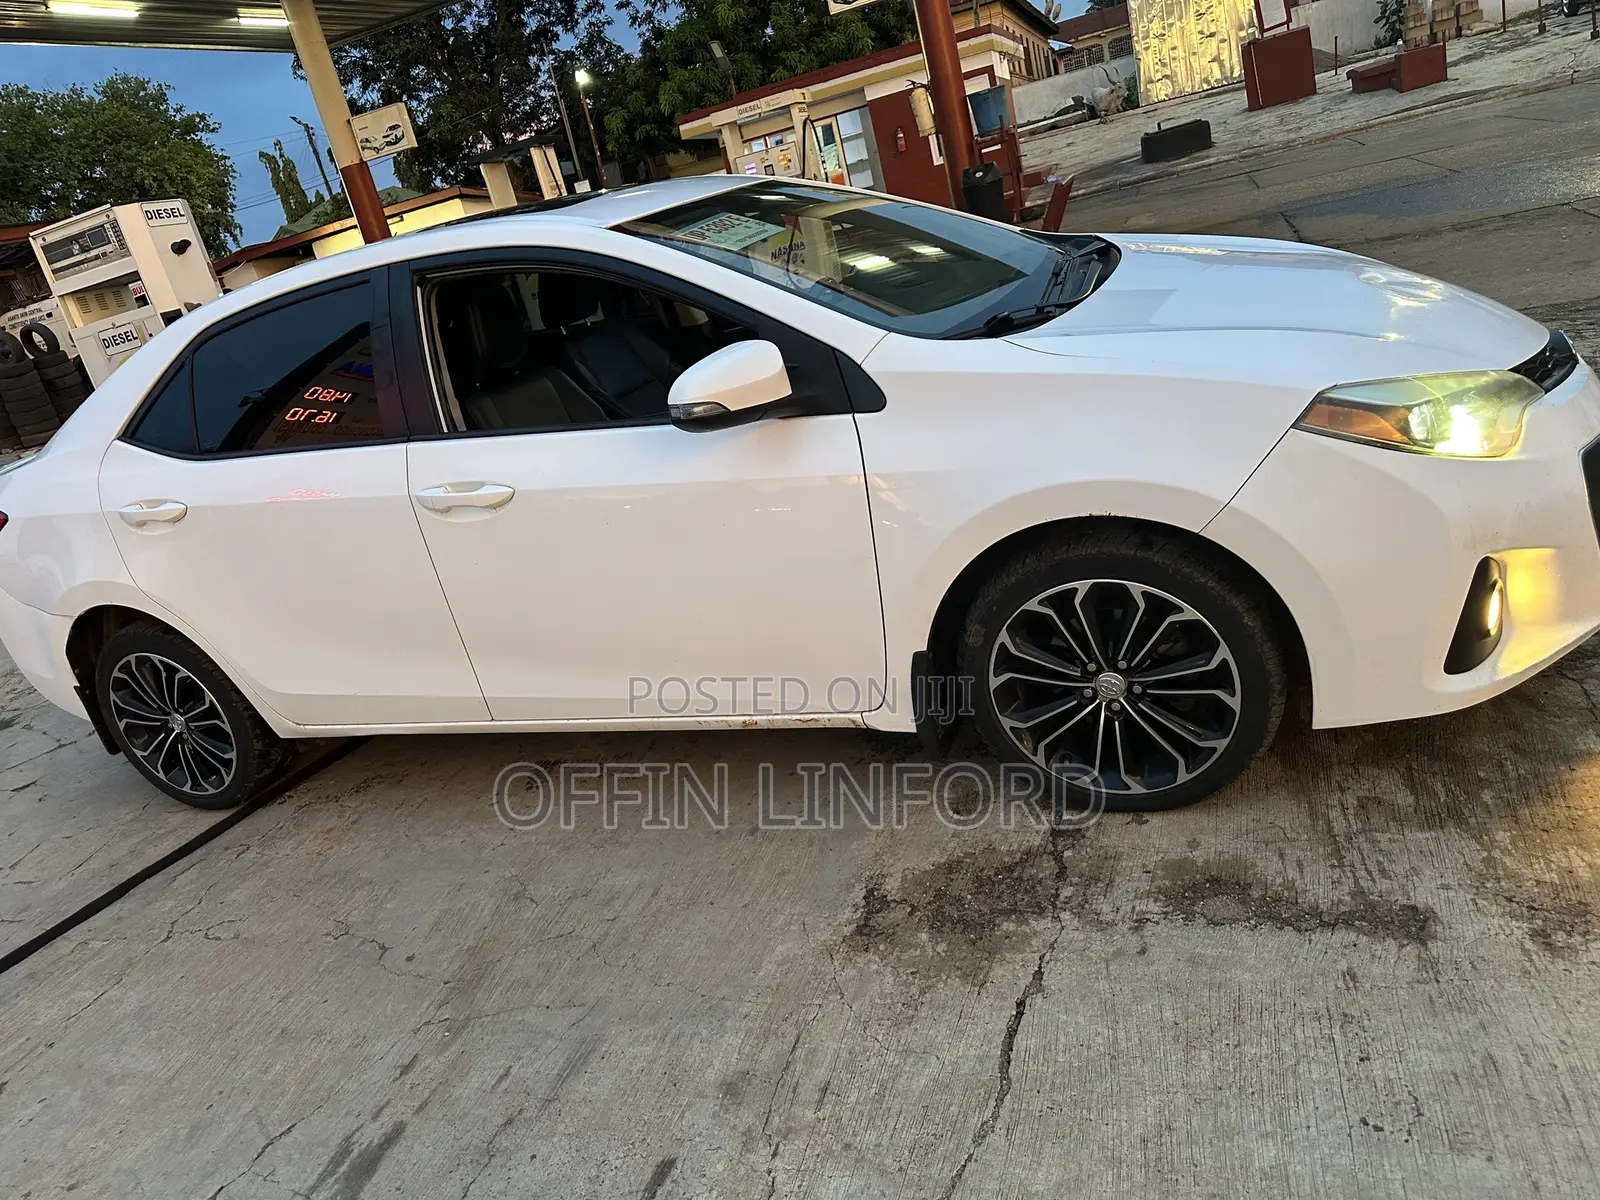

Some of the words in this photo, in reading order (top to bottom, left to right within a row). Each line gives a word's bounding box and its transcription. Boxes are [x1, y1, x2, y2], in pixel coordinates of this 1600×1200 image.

[738, 103, 761, 115] DIESEL
[145, 207, 185, 220] DIESEL
[102, 330, 138, 349] DIESEL
